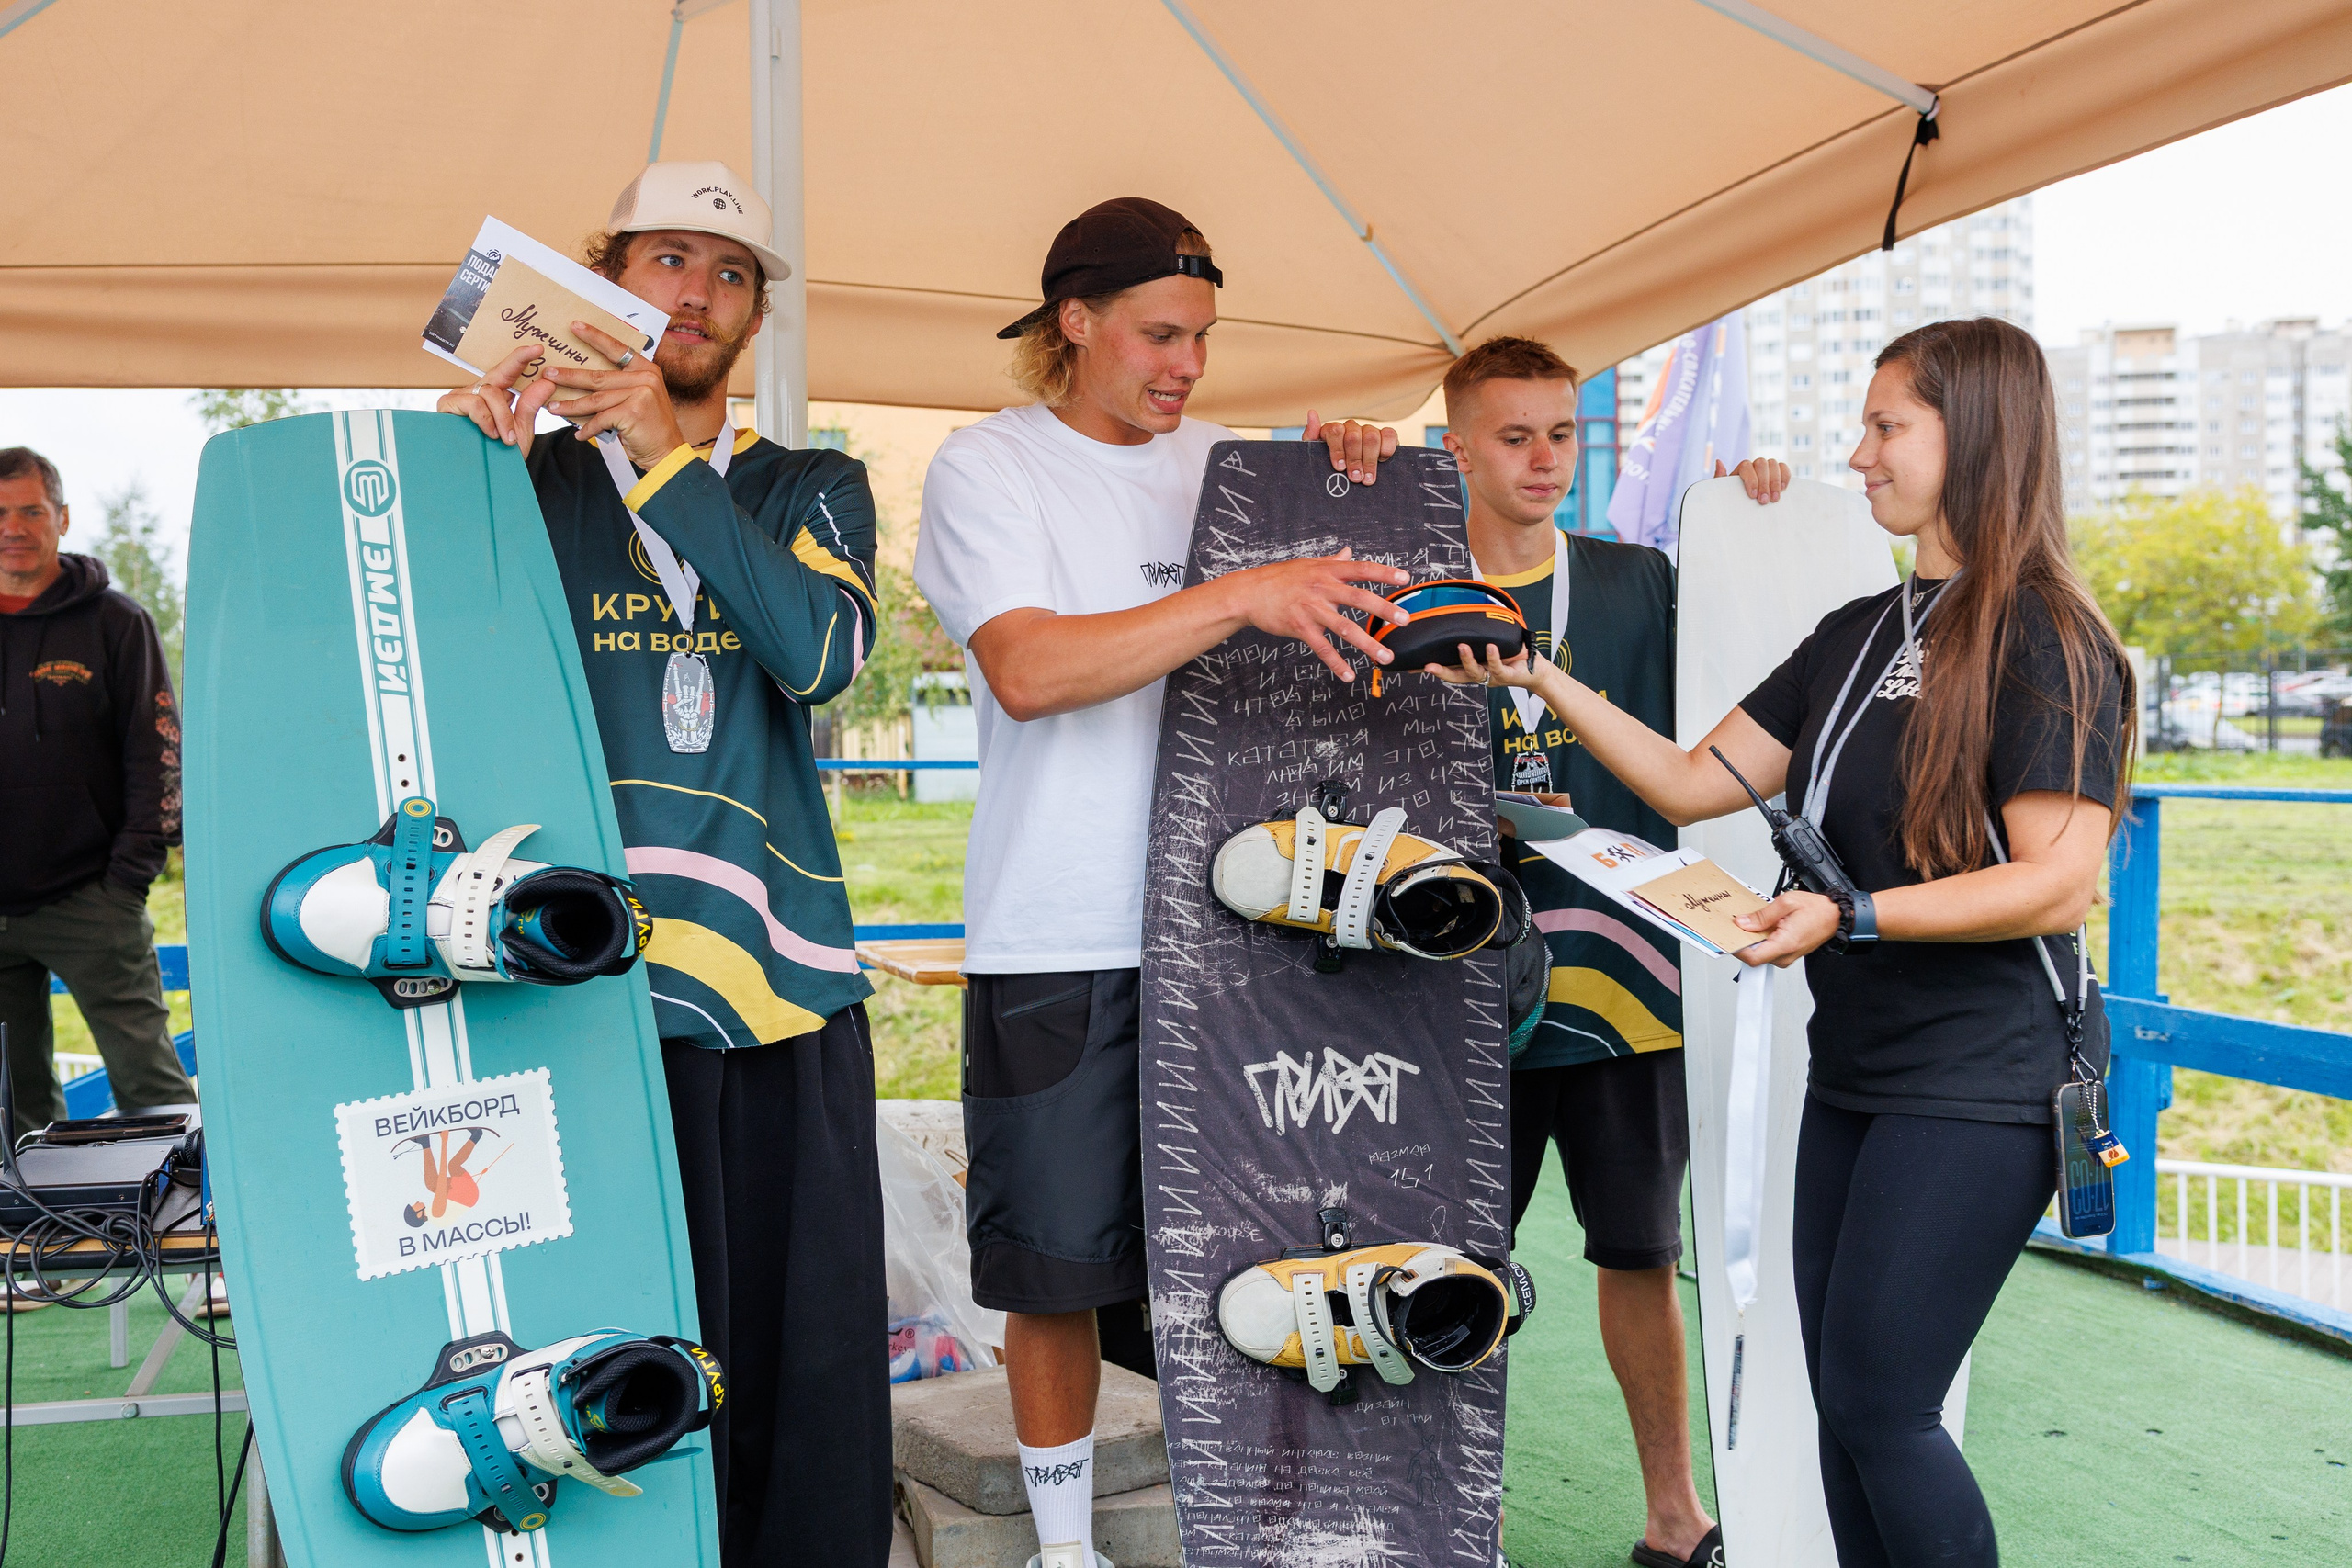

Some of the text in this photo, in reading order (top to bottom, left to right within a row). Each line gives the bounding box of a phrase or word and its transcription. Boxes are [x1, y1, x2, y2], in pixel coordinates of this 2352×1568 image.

[362, 545, 408, 693] ЭМДЭЙ
[375, 1093, 521, 1138] ВЕЙКБОРД
[399, 1212, 532, 1258] В МАССЫ!
